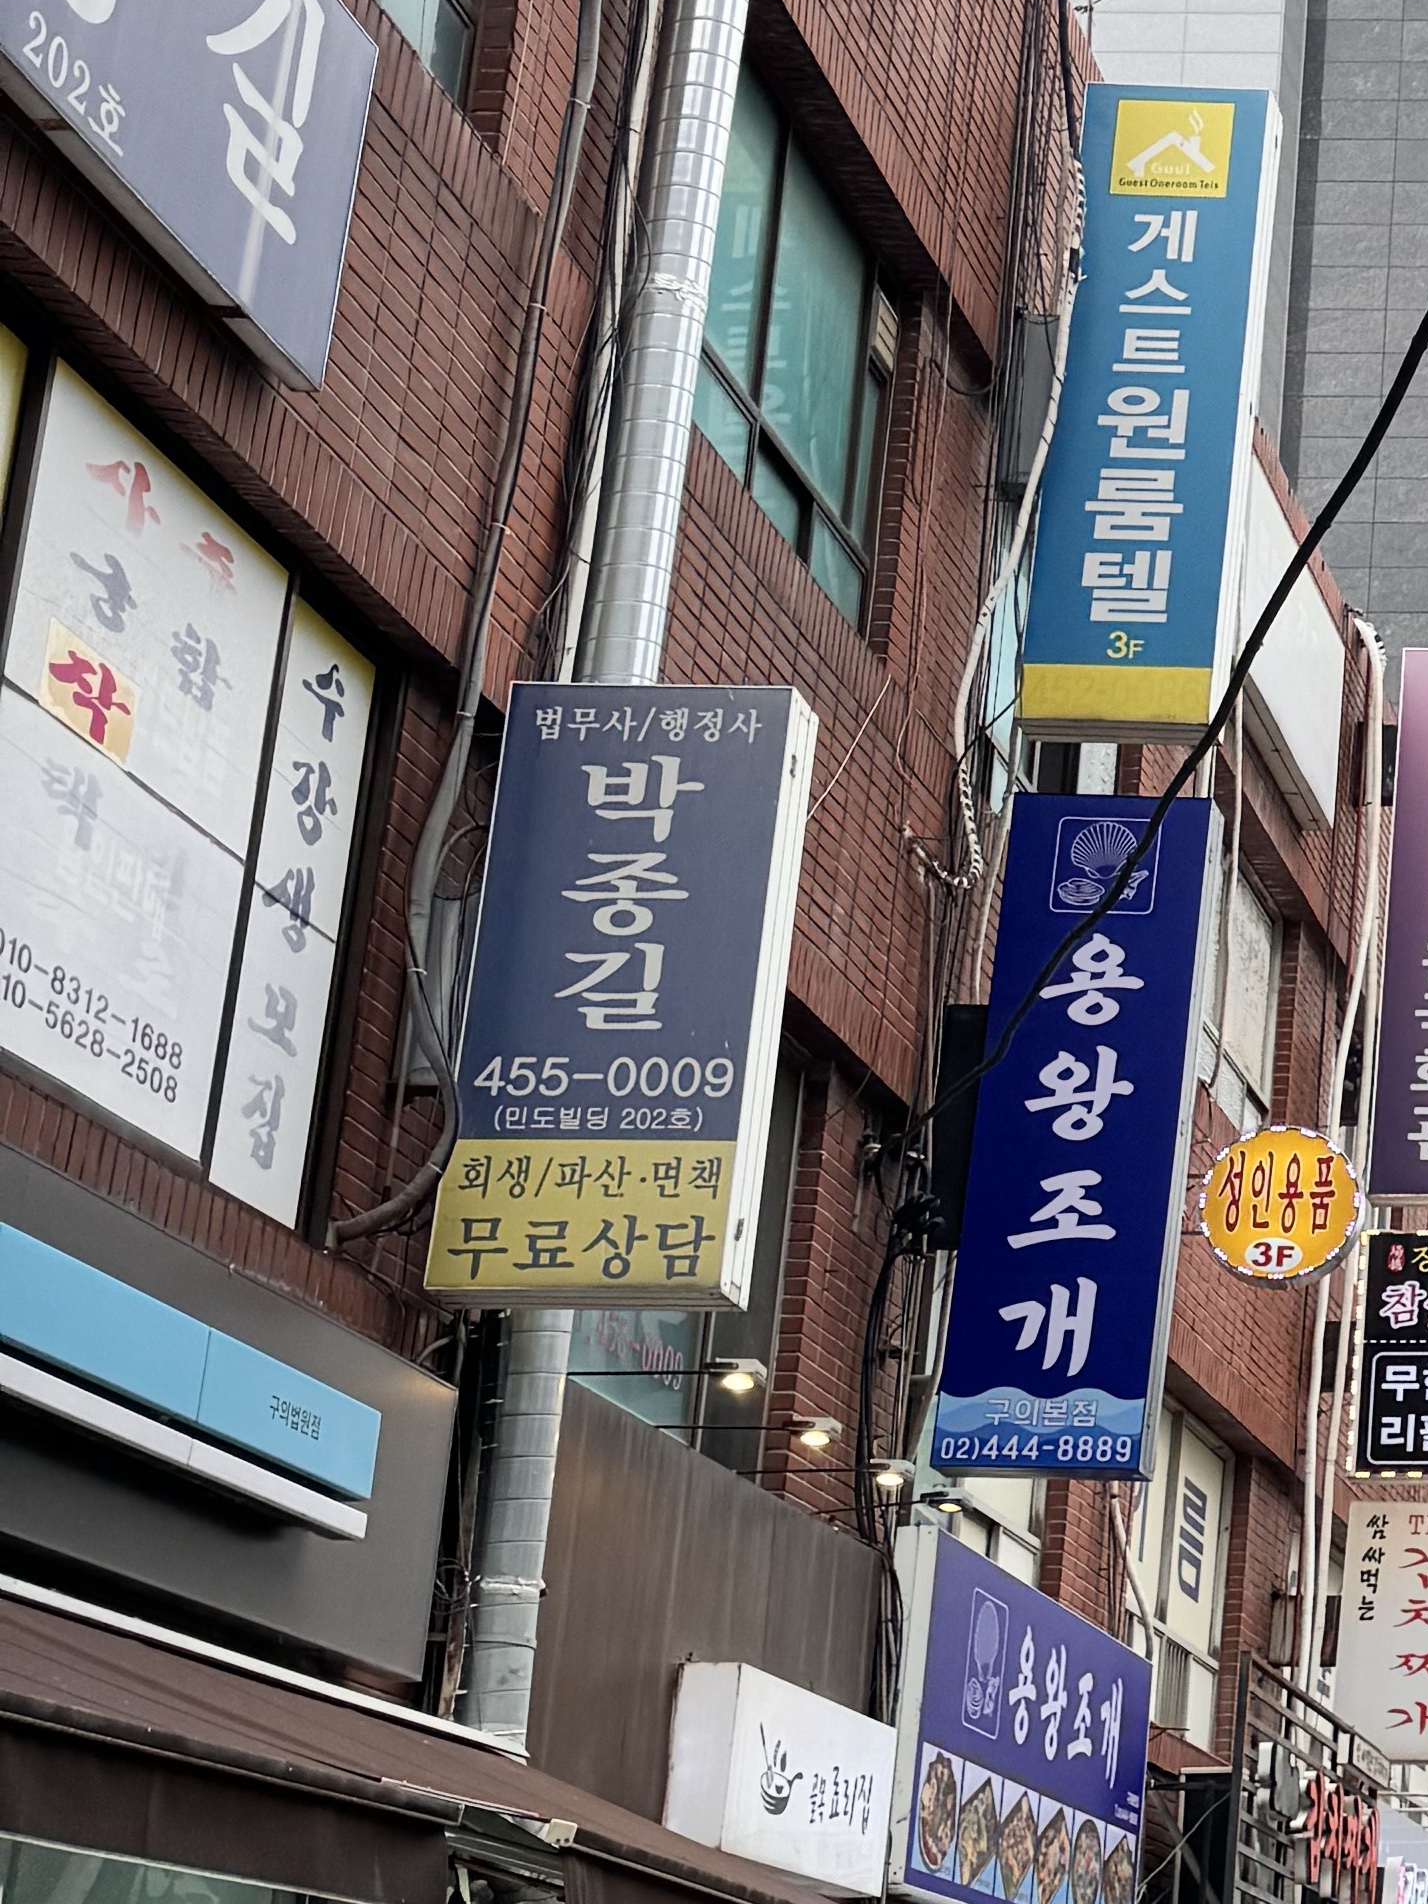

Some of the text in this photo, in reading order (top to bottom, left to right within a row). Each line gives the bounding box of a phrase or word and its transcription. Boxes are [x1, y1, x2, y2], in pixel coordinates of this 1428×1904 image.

[23, 14, 125, 156] 202호
[1106, 632, 1144, 659] 3F
[535, 707, 762, 745] 법무사/행정사
[243, 664, 346, 1171] 수강생 모집
[554, 755, 704, 1030] 박종길
[474, 1057, 735, 1097] 455-0009
[494, 1107, 704, 1133] (민도빌딩 202호)
[999, 934, 1144, 1378] 용왕조개
[1219, 1149, 1336, 1235] 성인용품
[447, 1217, 715, 1280] 무료상담
[1251, 1242, 1296, 1271] 3F
[270, 1394, 322, 1442] 구의법원점
[984, 1399, 1097, 1428] 구의본점
[940, 1436, 1132, 1464] 02)444-8889
[1357, 1515, 1389, 1622] 쌈 싸먹는
[1008, 1625, 1124, 1789] 용왕조개
